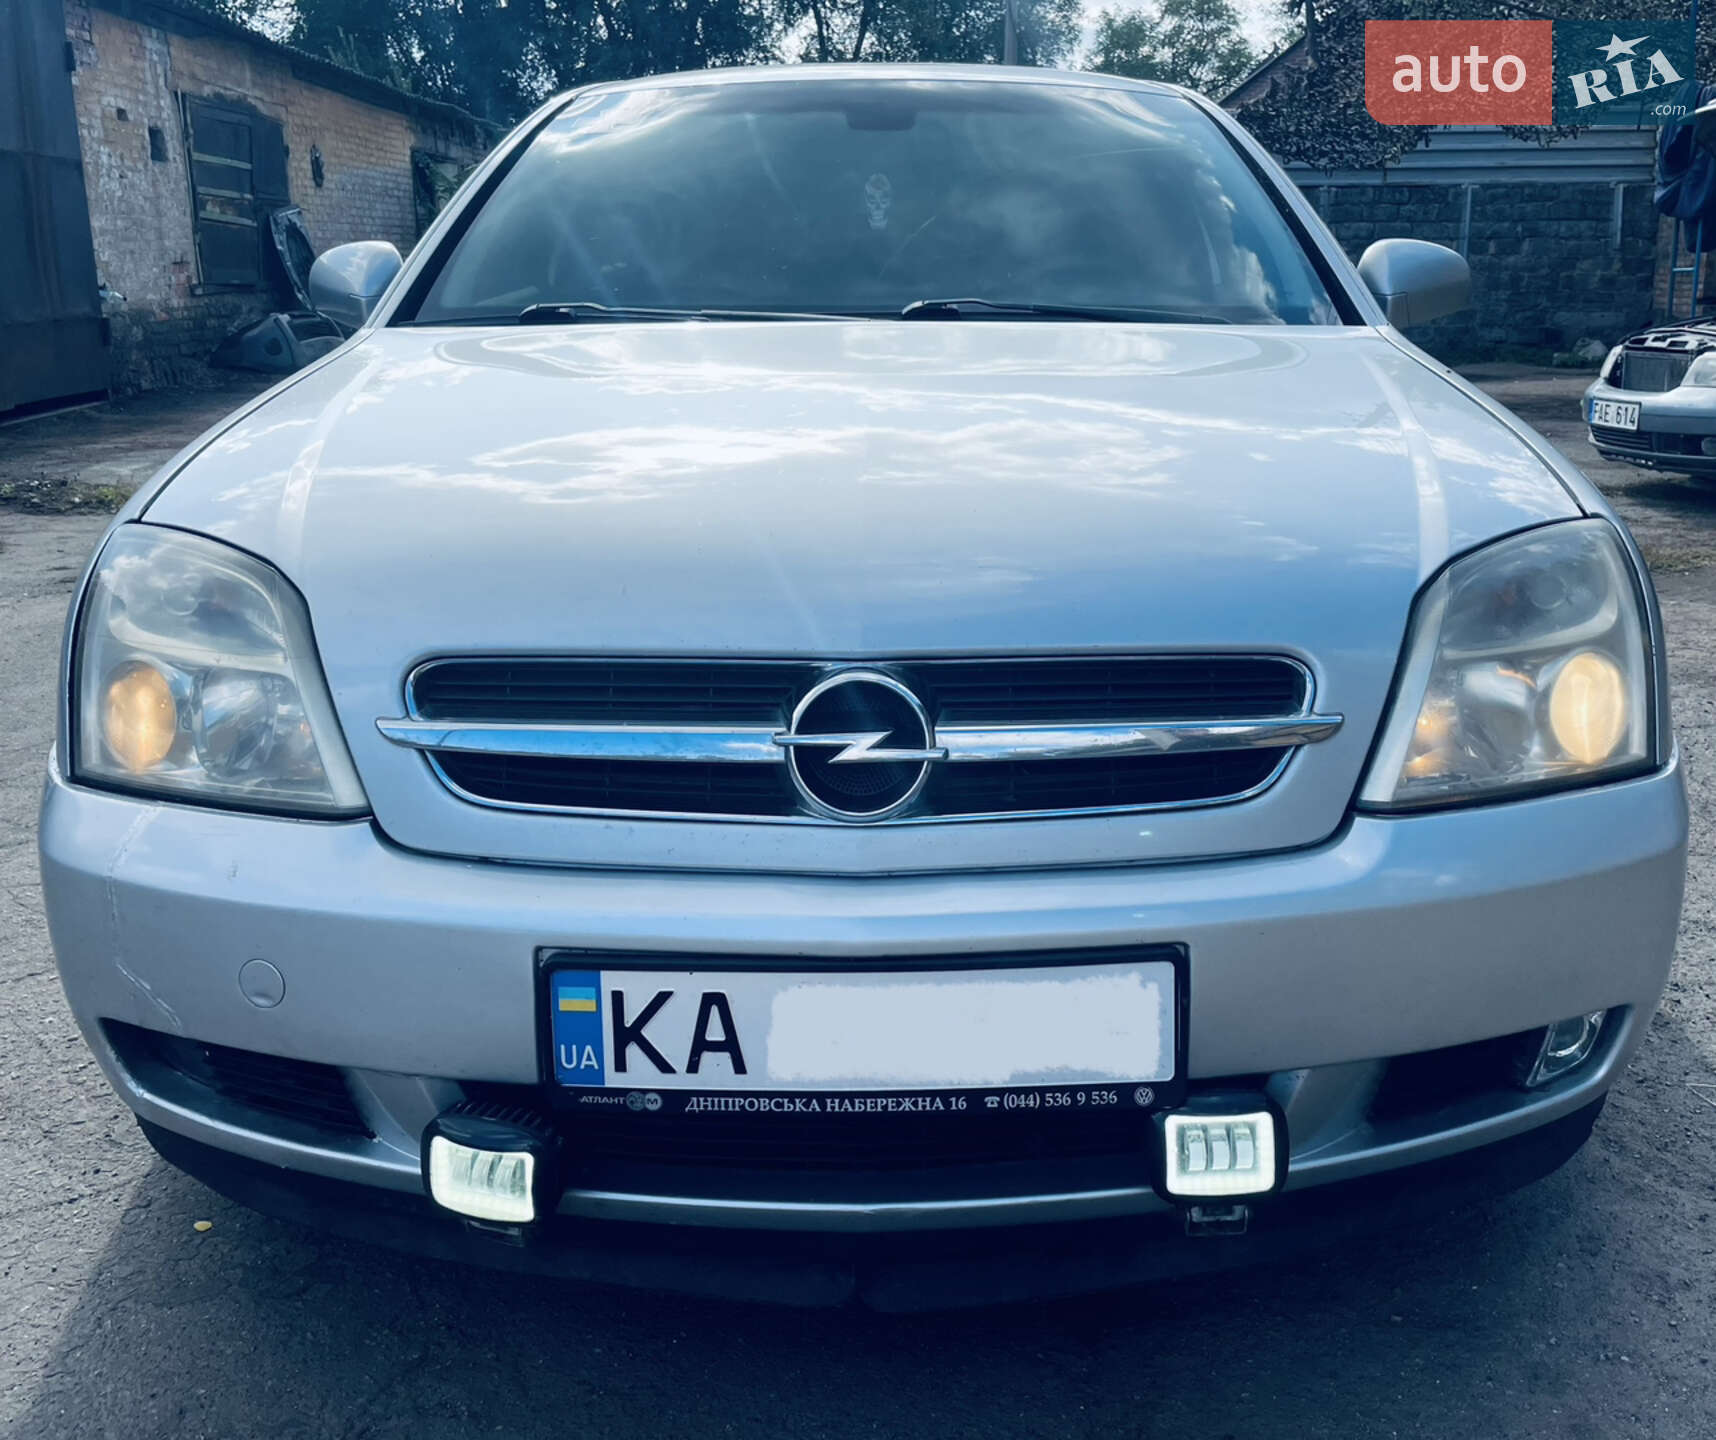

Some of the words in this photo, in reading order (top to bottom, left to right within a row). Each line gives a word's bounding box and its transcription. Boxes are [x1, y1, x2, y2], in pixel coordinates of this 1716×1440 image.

[1594, 402, 1611, 423] FAE
[1616, 406, 1636, 427] 614
[611, 989, 748, 1075] KA
[560, 1044, 599, 1069] UA
[580, 1095, 624, 1104] АТЛАНТ
[685, 1097, 821, 1113] ДНІПРОВСЬКА
[826, 1097, 945, 1112] НАБЕРЕЖНА
[949, 1097, 967, 1110] 16
[1003, 1092, 1040, 1110] (044)
[1044, 1092, 1072, 1107] 536
[1076, 1092, 1086, 1106] 9
[1091, 1090, 1118, 1105] 536
